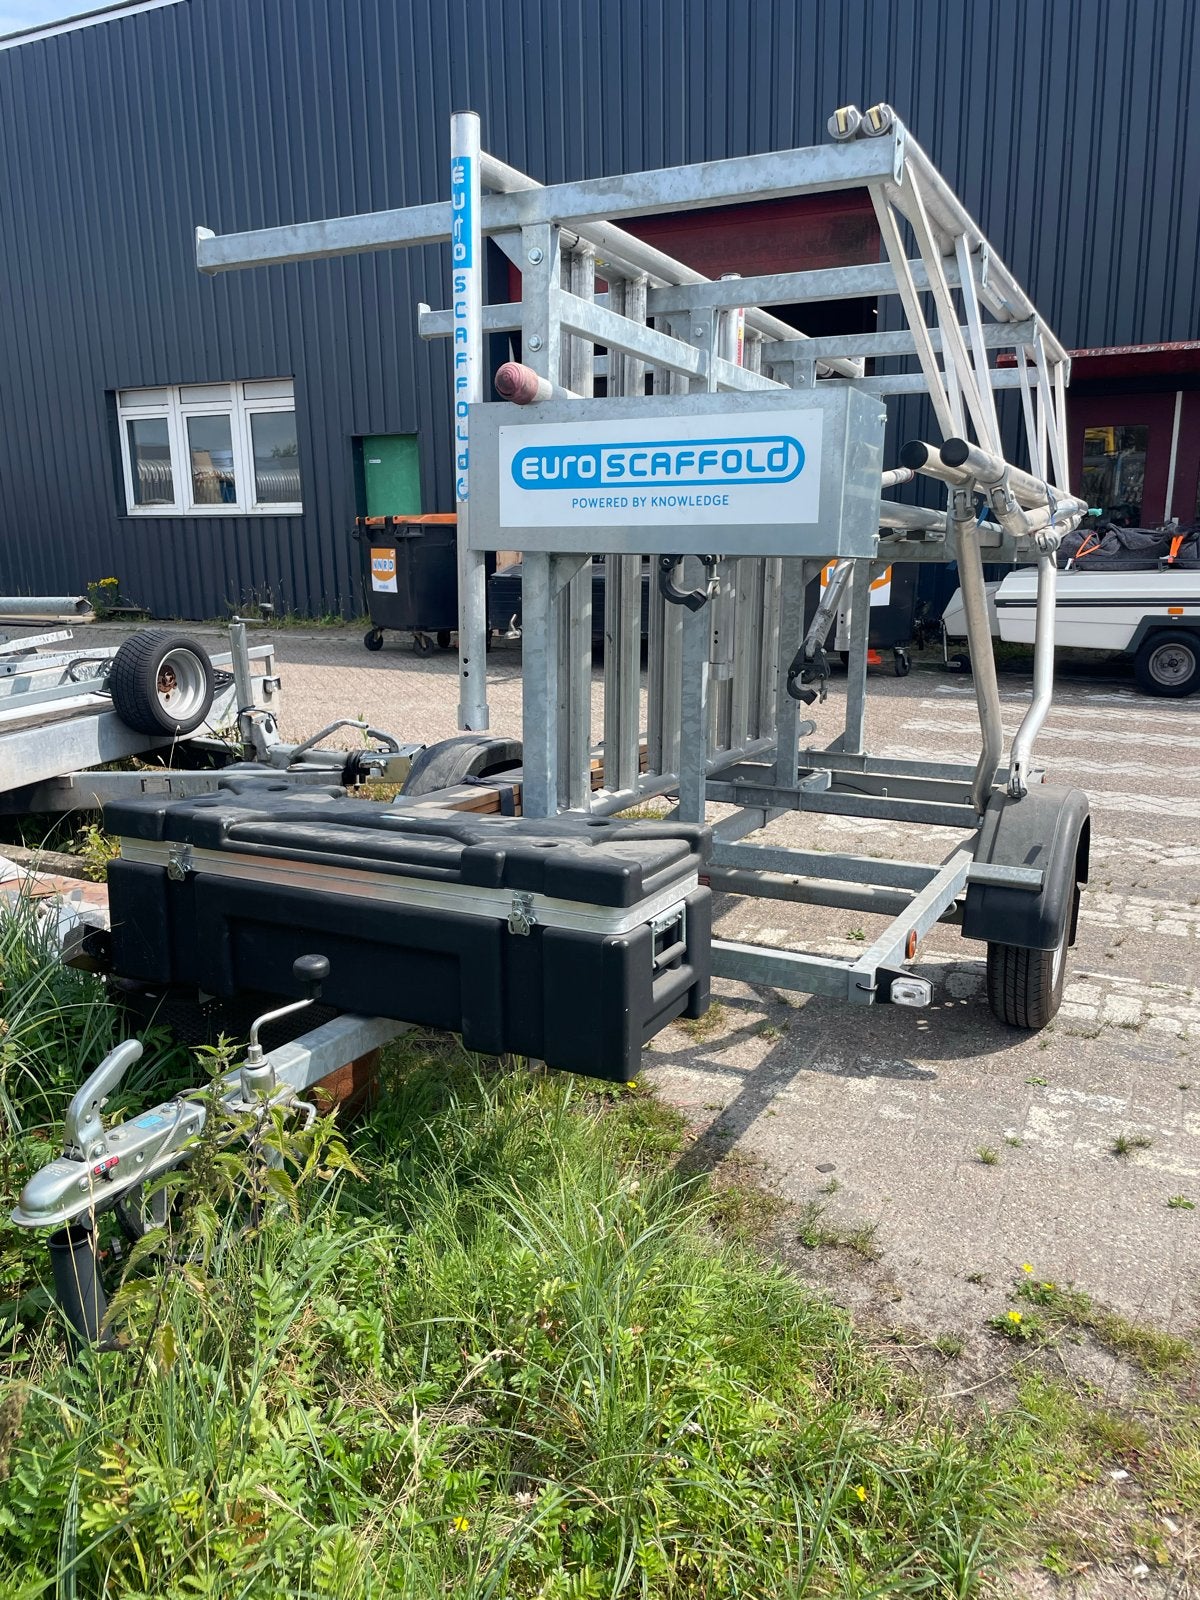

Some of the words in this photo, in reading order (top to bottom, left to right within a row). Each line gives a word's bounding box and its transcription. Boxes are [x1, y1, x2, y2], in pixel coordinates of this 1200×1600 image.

[572, 497, 628, 508] POWERED
[632, 496, 647, 508] BY
[651, 494, 729, 507] KNOWLEDGE
